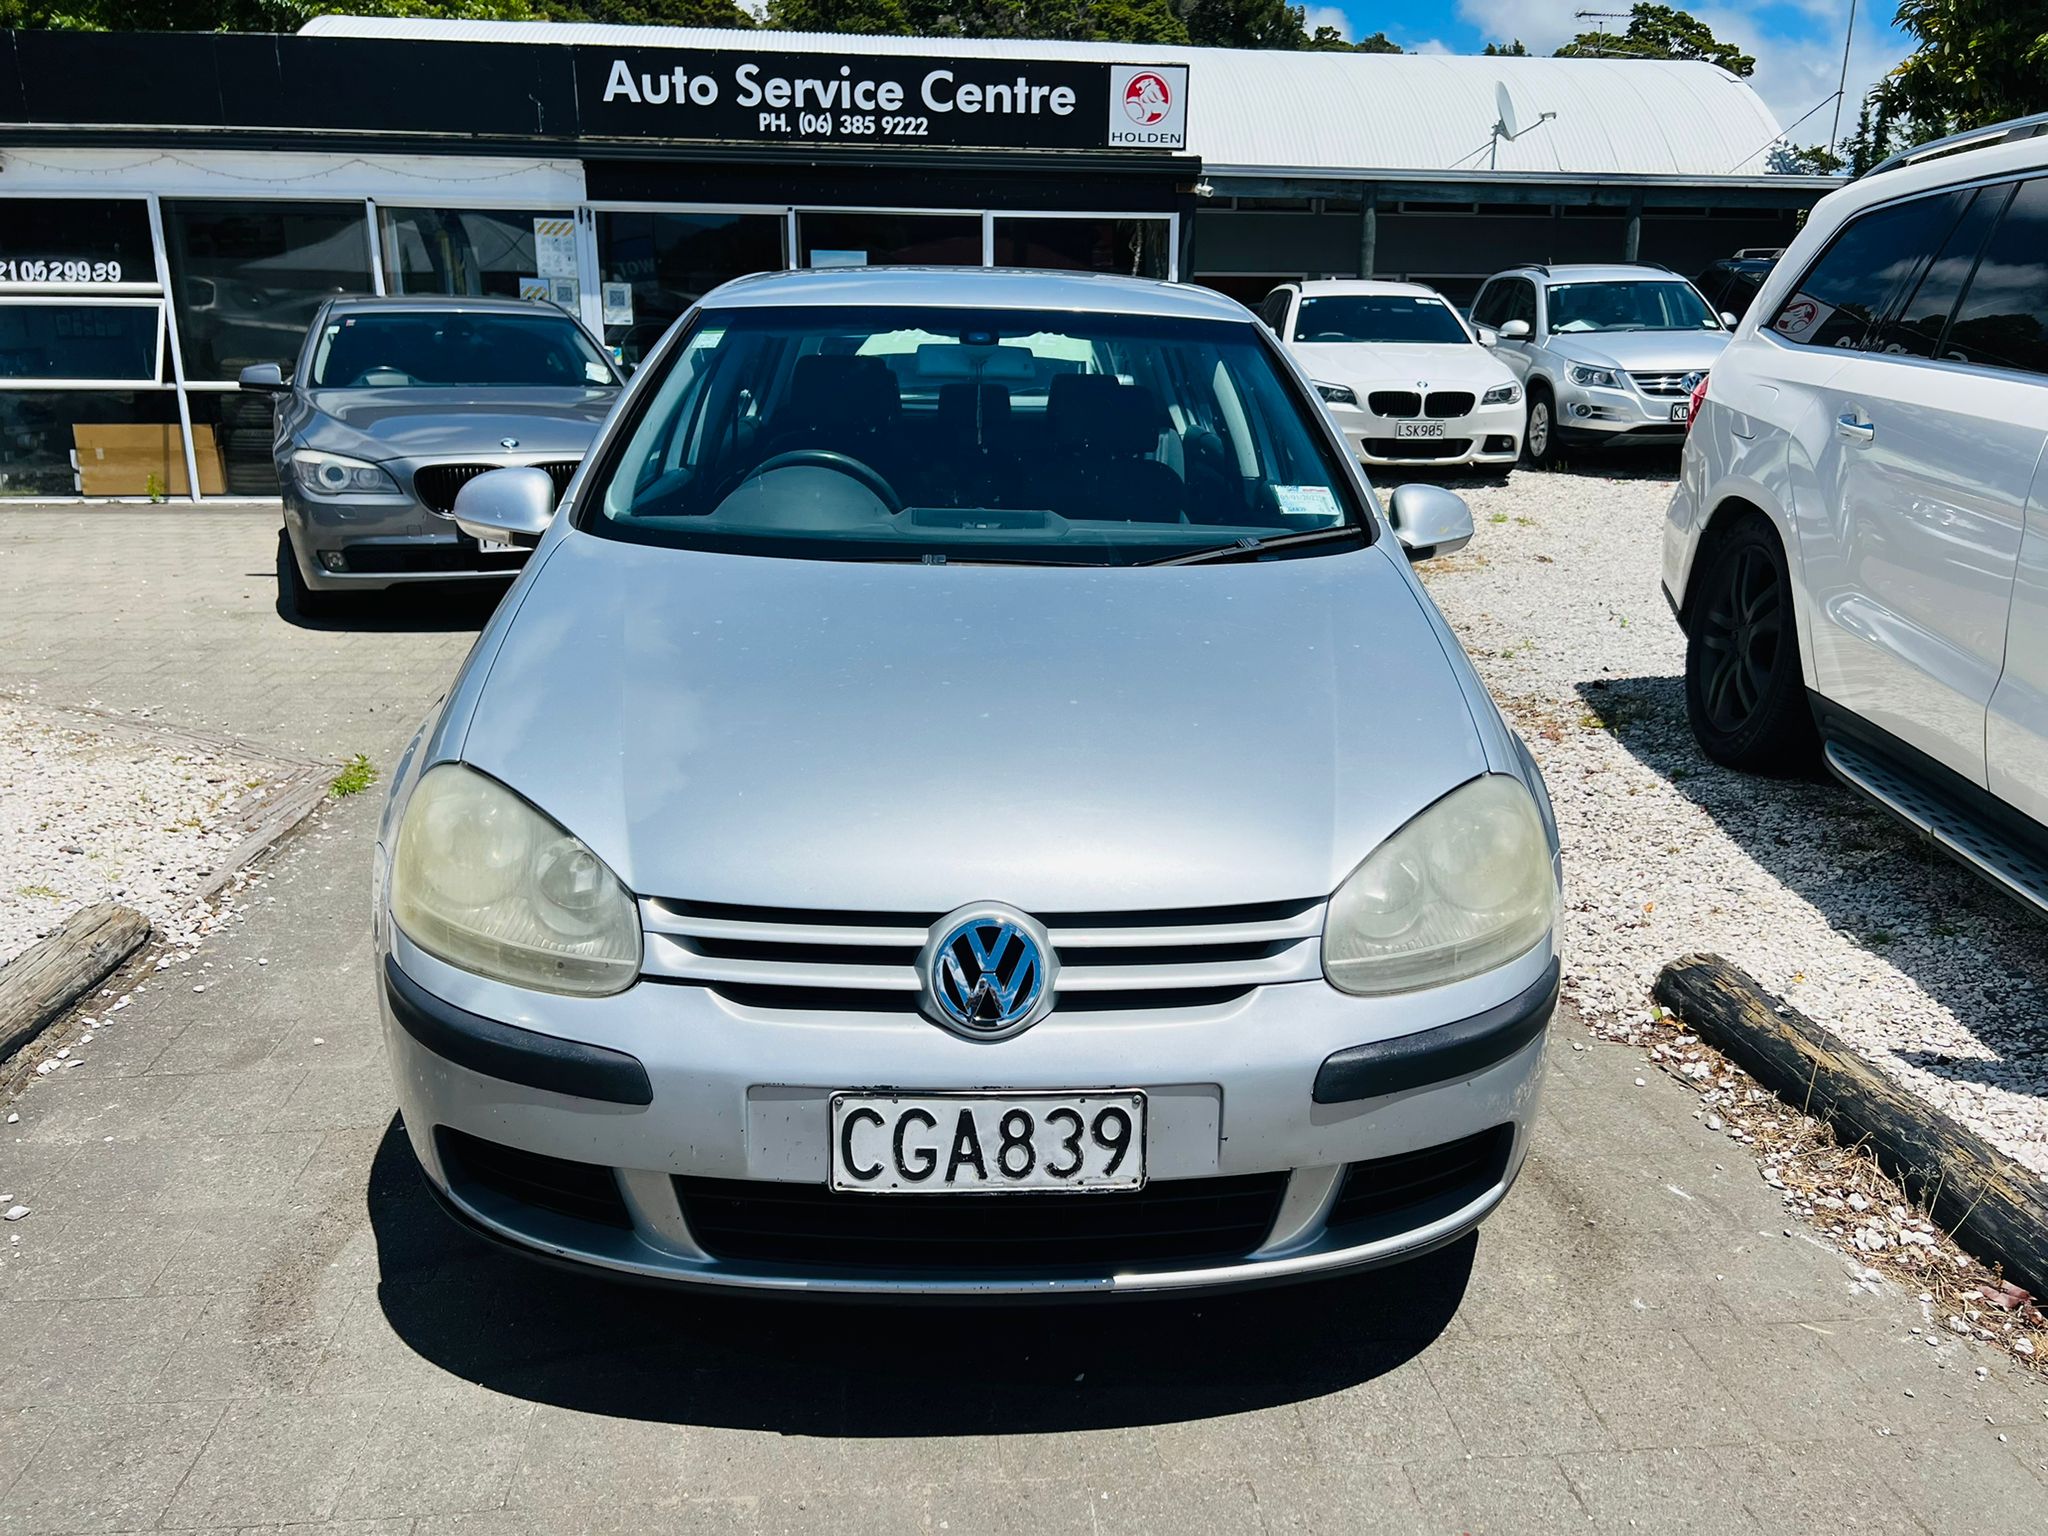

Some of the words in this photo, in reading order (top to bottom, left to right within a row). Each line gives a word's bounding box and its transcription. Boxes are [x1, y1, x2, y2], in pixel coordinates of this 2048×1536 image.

[603, 59, 719, 106] Auto
[735, 63, 905, 111] Service
[921, 70, 1077, 116] Centre
[759, 112, 791, 132] PH.
[799, 112, 833, 136] (06)
[840, 115, 876, 135] 385
[882, 116, 929, 137] 9222
[1111, 131, 1181, 144] HOLDEN
[1398, 424, 1444, 437] LSK905
[841, 1106, 1133, 1183] CGA839
